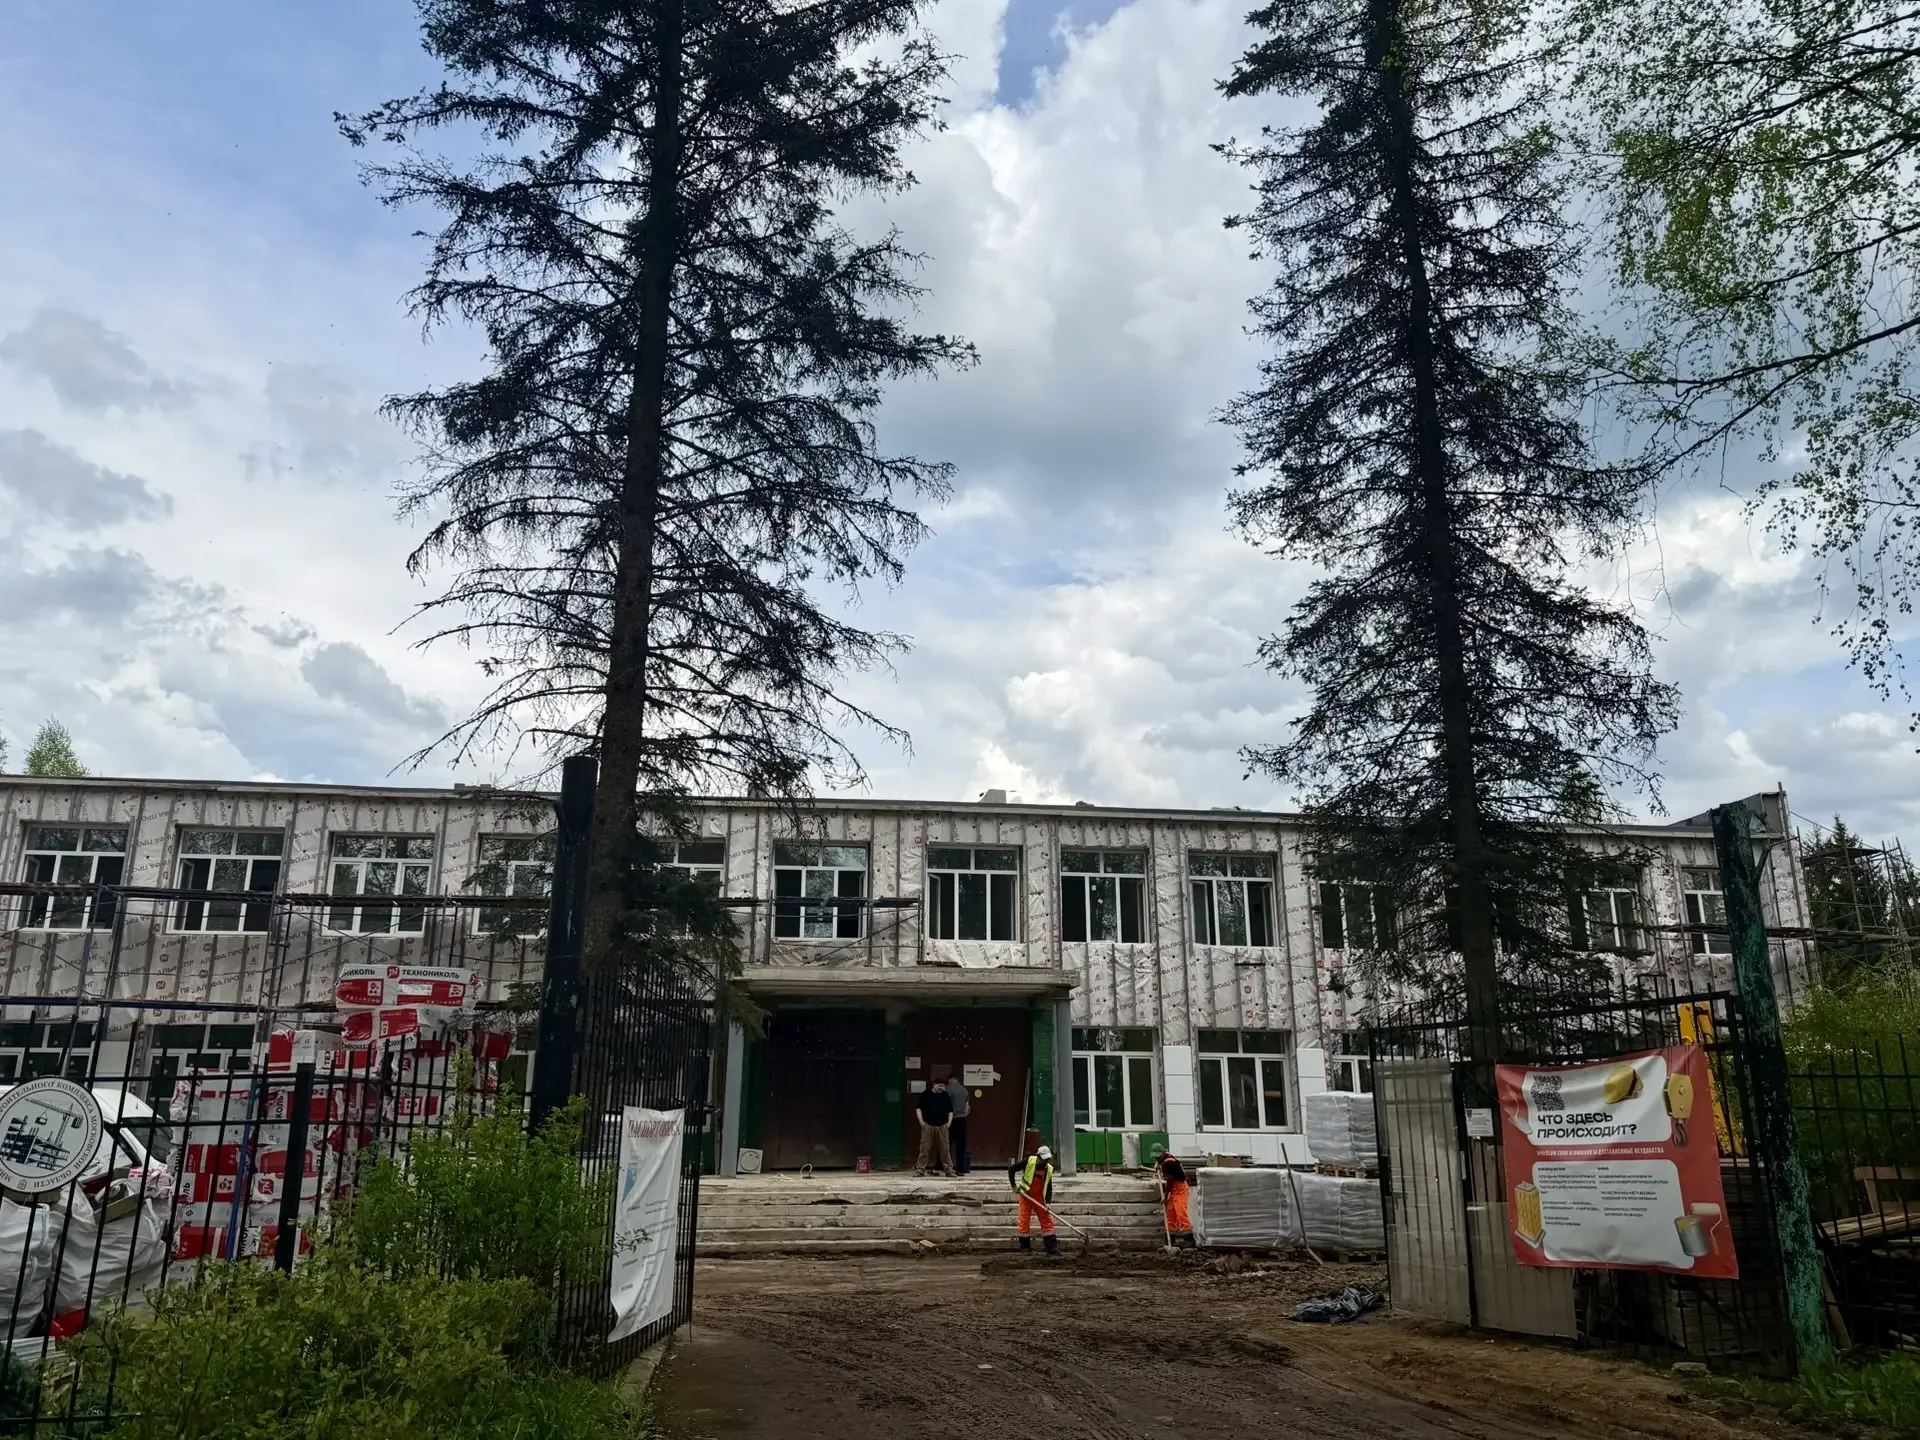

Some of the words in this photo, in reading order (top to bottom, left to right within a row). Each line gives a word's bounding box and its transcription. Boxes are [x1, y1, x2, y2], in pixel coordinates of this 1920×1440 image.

[342, 969, 375, 978] НИКОЛЬ
[402, 969, 461, 980] ТЕХНОНИКОЛЬ
[1538, 1113, 1563, 1125] ЧТО
[1566, 1112, 1613, 1125] ЗДЕСЬ
[1537, 1124, 1637, 1138] ПРОИСХОДИТ?
